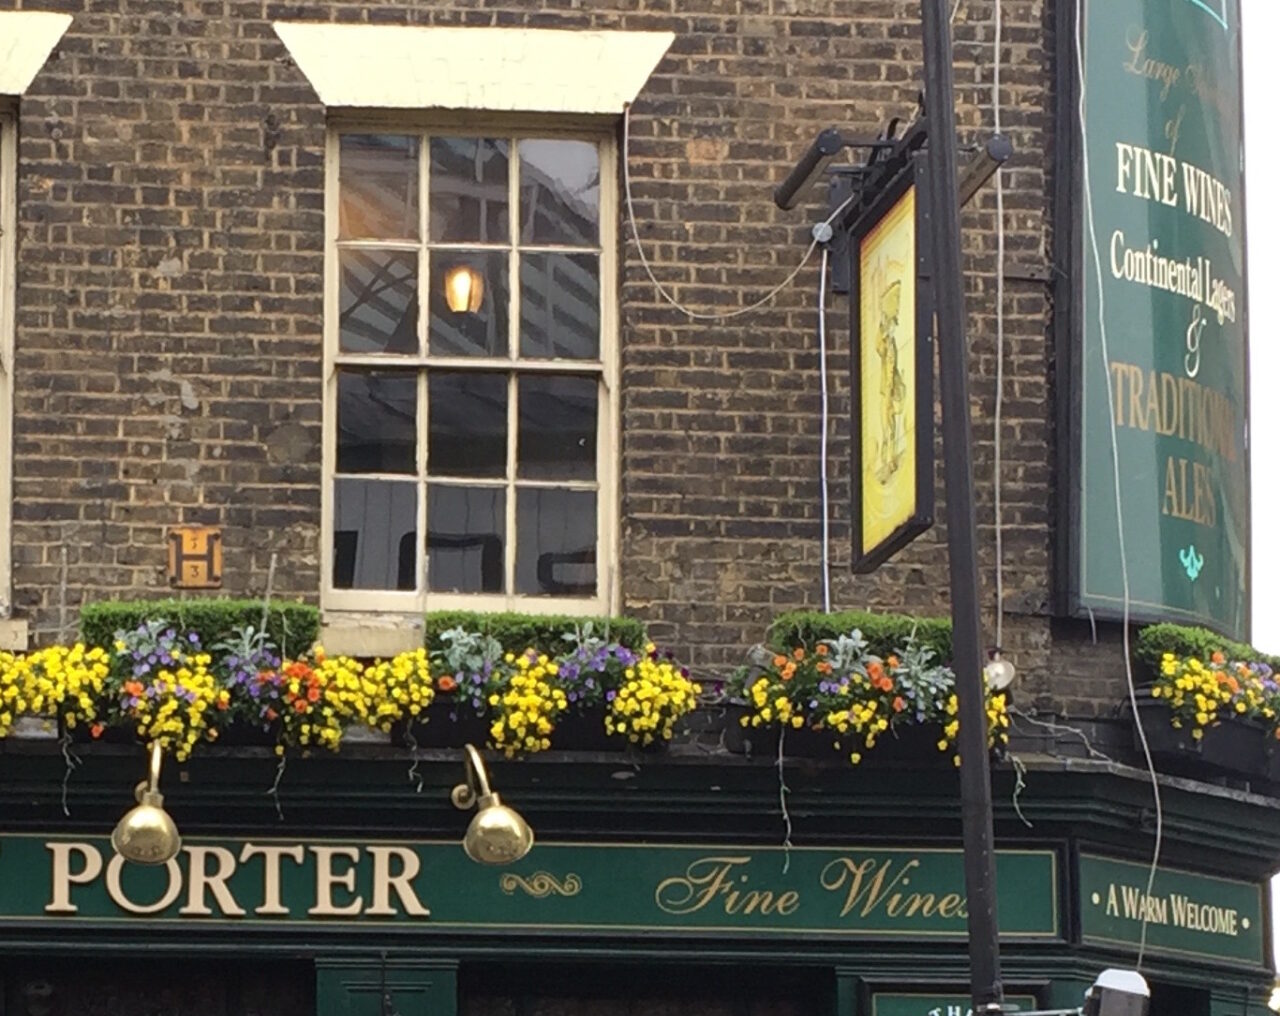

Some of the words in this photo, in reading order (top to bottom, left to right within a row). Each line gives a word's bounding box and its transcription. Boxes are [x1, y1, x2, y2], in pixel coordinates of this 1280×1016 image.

[1116, 142, 1177, 206] FINE
[1181, 162, 1232, 237] WINES
[1110, 230, 1202, 302] Continental
[1162, 456, 1216, 528] ALES
[44, 841, 430, 916] PORTER
[655, 856, 800, 915] Fine
[1106, 884, 1119, 917] A
